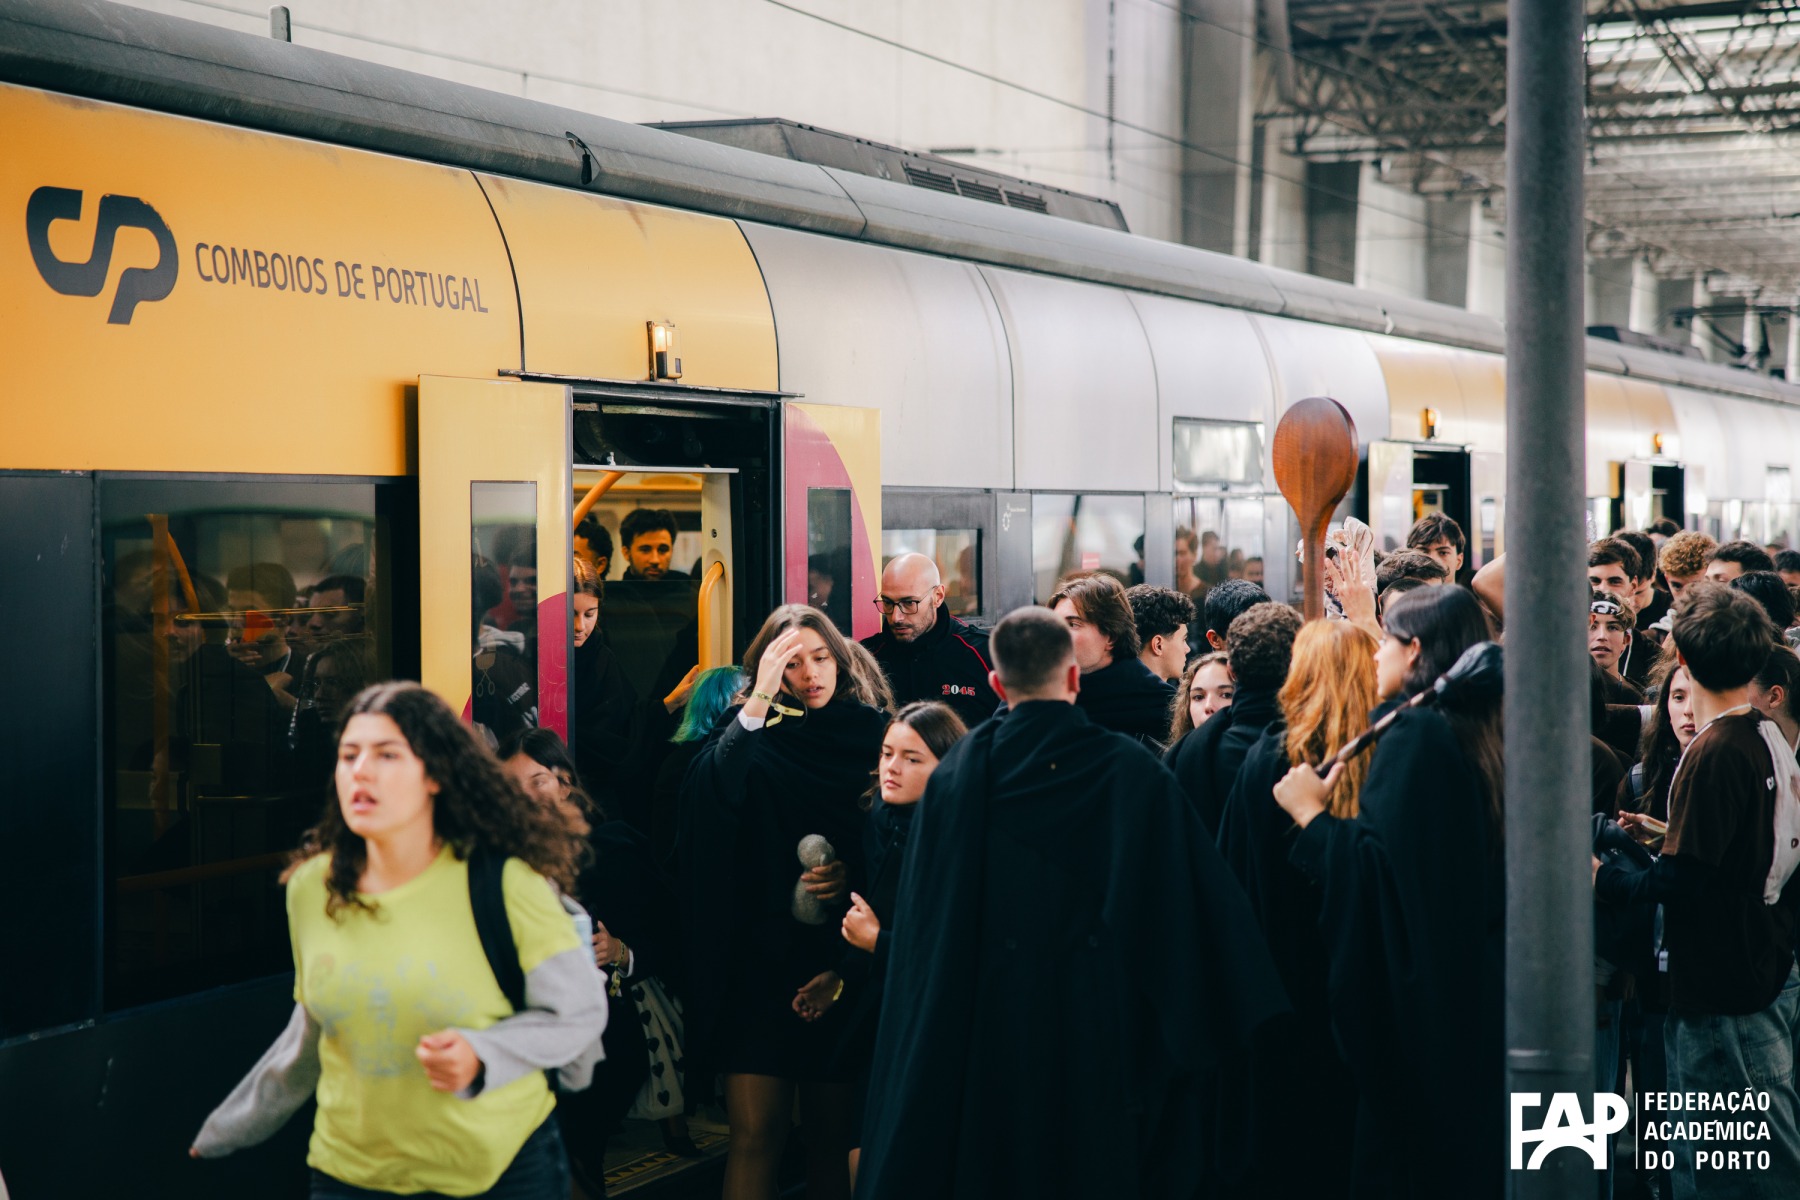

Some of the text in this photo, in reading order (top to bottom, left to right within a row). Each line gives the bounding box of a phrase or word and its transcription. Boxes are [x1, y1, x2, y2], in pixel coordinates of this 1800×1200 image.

[195, 242, 489, 314] COMBOIOS DE PORTUGAL
[941, 683, 976, 697] 2045
